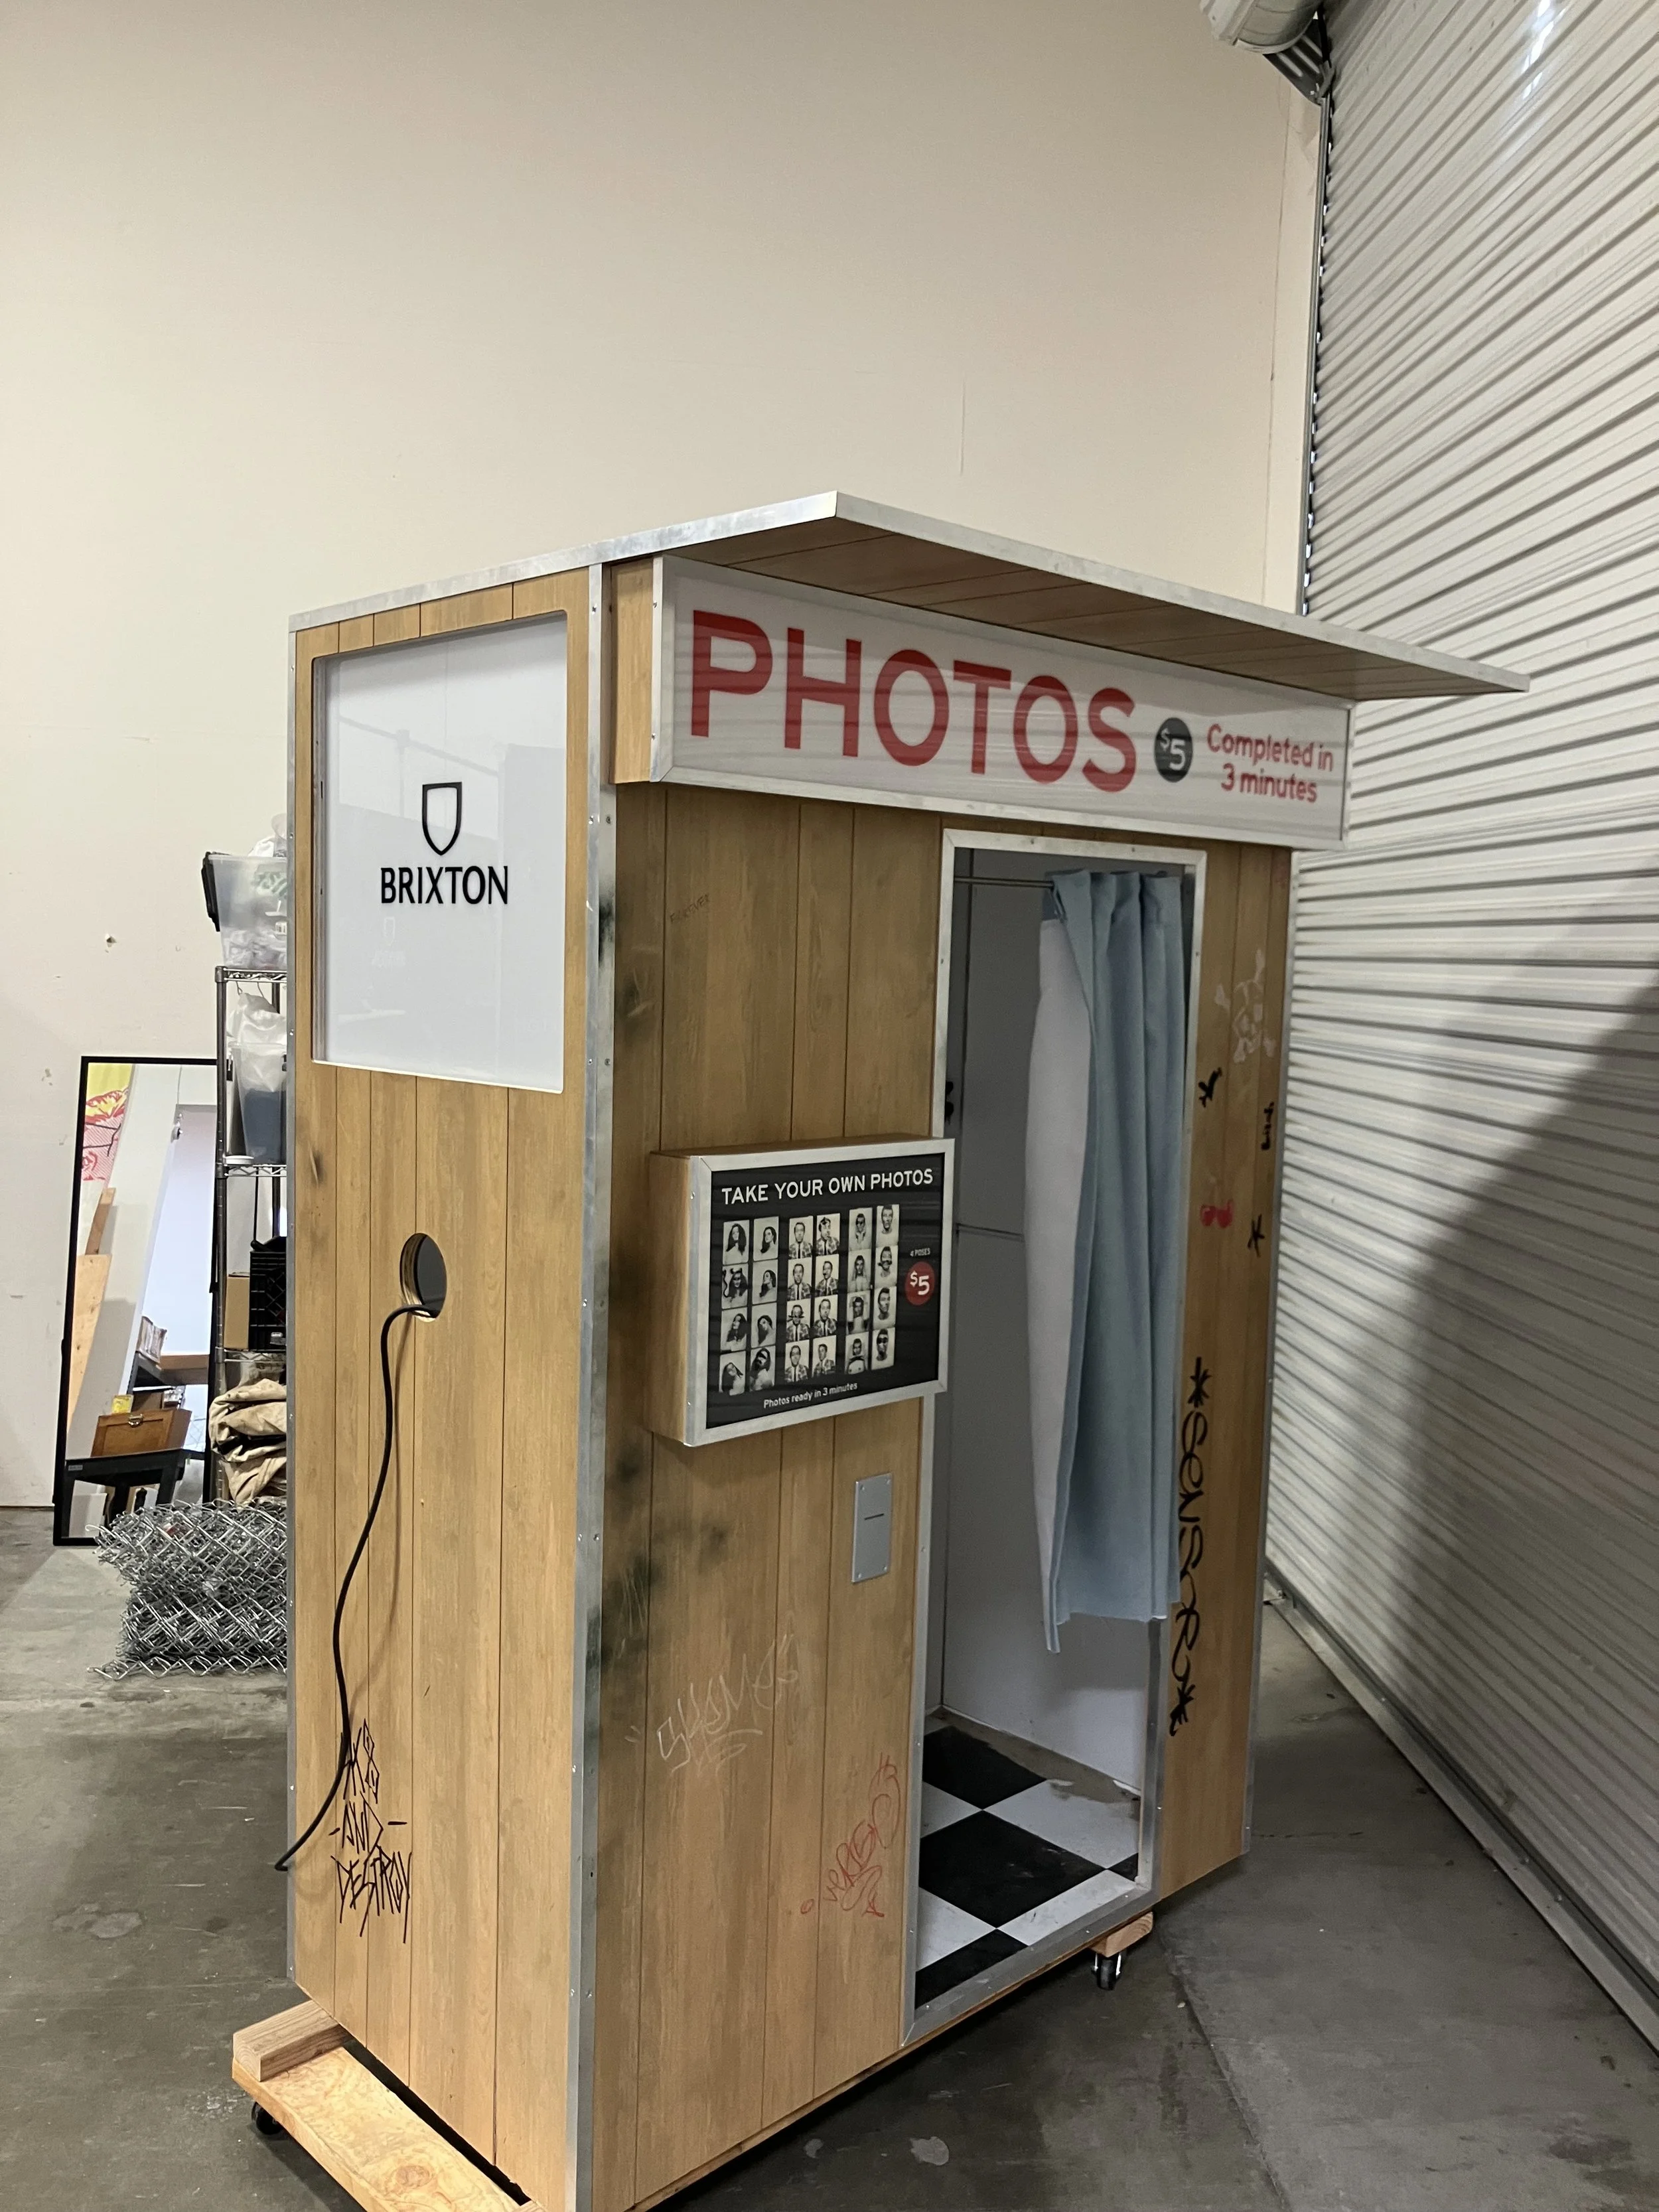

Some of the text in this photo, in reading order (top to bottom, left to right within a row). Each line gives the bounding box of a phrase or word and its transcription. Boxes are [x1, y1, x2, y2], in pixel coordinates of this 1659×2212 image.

[691, 610, 1137, 792] PHOTOS
[1161, 728, 1186, 771] $5
[1206, 723, 1333, 772] Completed in
[1221, 763, 1317, 803] 3 minutes
[380, 865, 508, 905] BRIXTON
[721, 1168, 933, 1205] TAKE YOUR OWN PHOTOS
[910, 1270, 930, 1295] $5
[764, 1382, 857, 1408] Photos ready in 3 minutes
